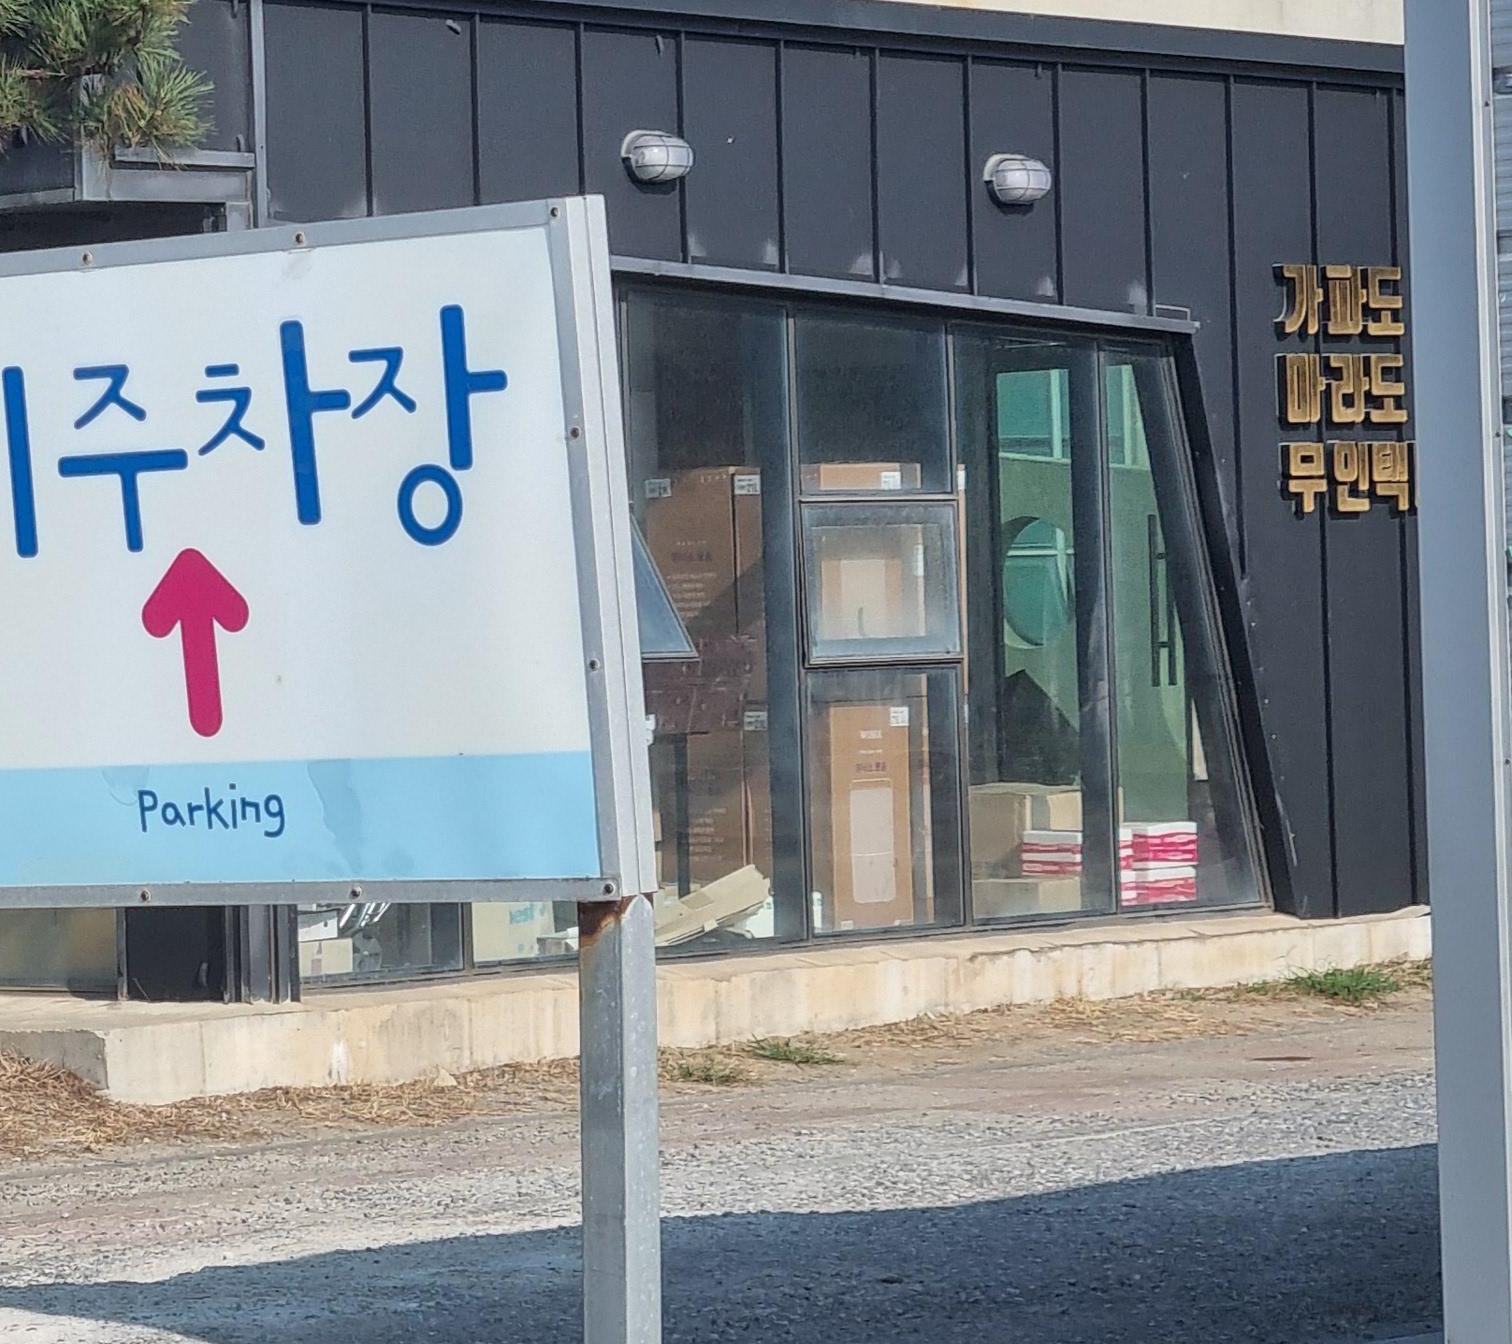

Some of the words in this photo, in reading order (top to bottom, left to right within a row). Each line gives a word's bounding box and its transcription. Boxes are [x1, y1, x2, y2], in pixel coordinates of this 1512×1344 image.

[1281, 264, 1405, 336] 가파도
[1285, 353, 1408, 424] 마라도
[1287, 441, 1418, 513] 무인택
[137, 783, 287, 839] Parking
